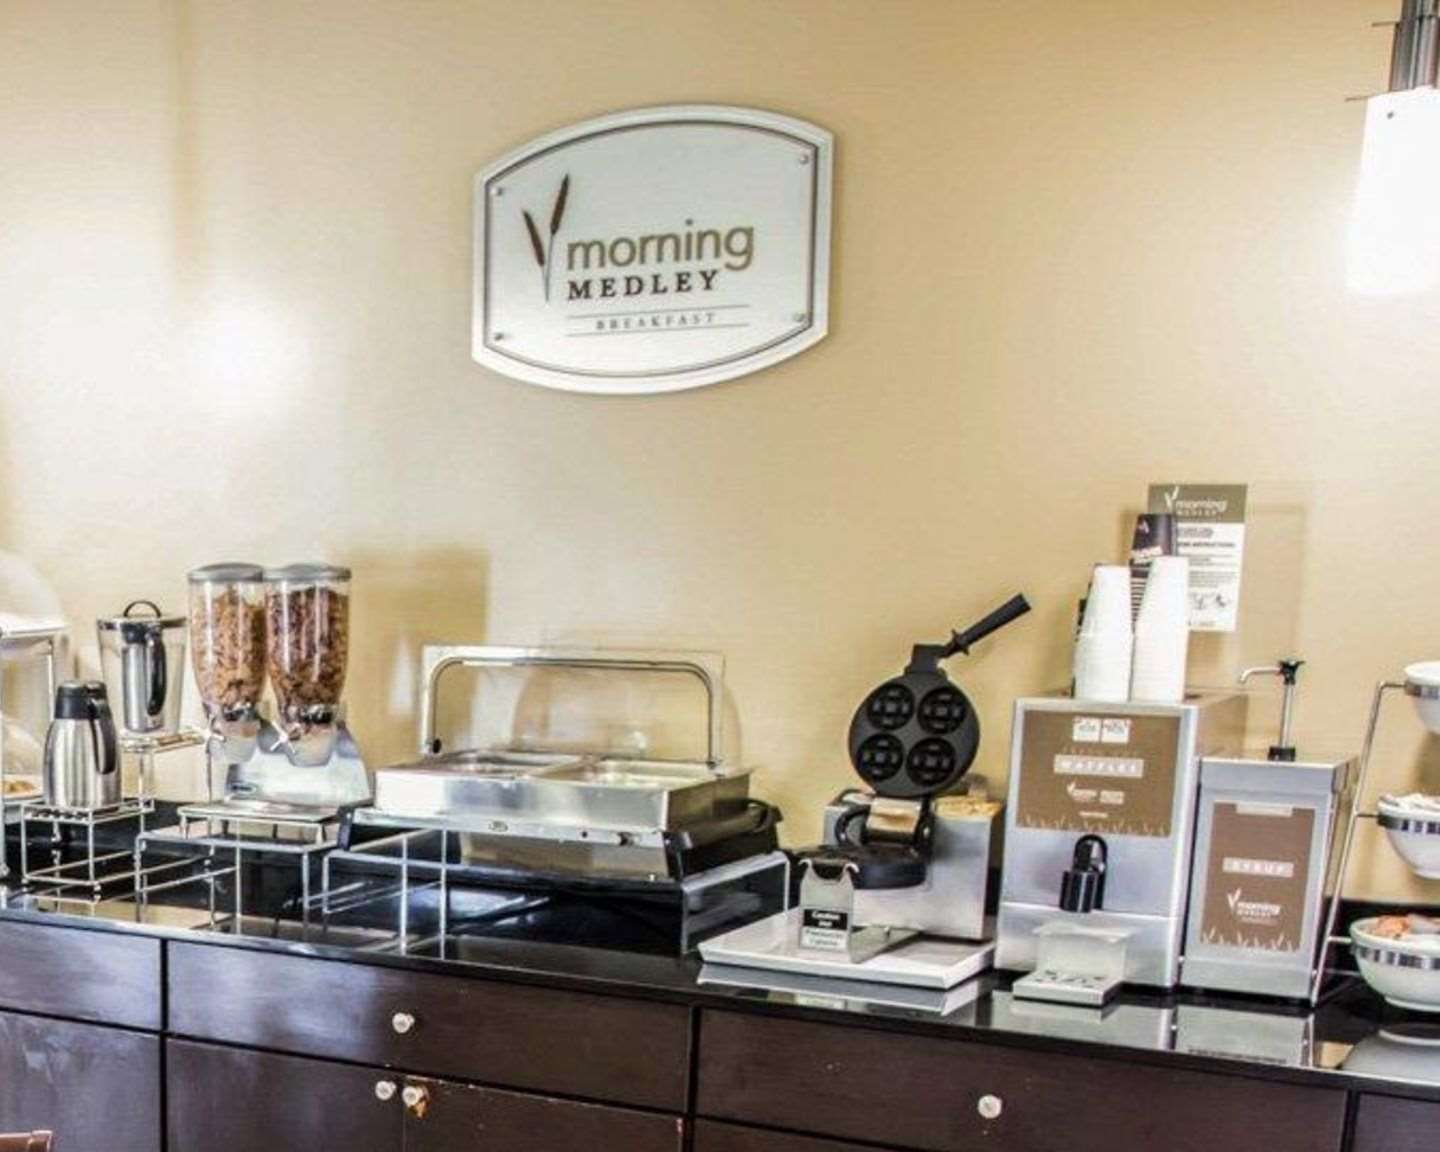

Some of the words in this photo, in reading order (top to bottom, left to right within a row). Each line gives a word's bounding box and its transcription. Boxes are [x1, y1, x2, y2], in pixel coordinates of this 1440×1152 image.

[566, 217, 755, 272] morning
[567, 269, 720, 301] MEDLEY
[596, 312, 716, 331] BREAKFAST
